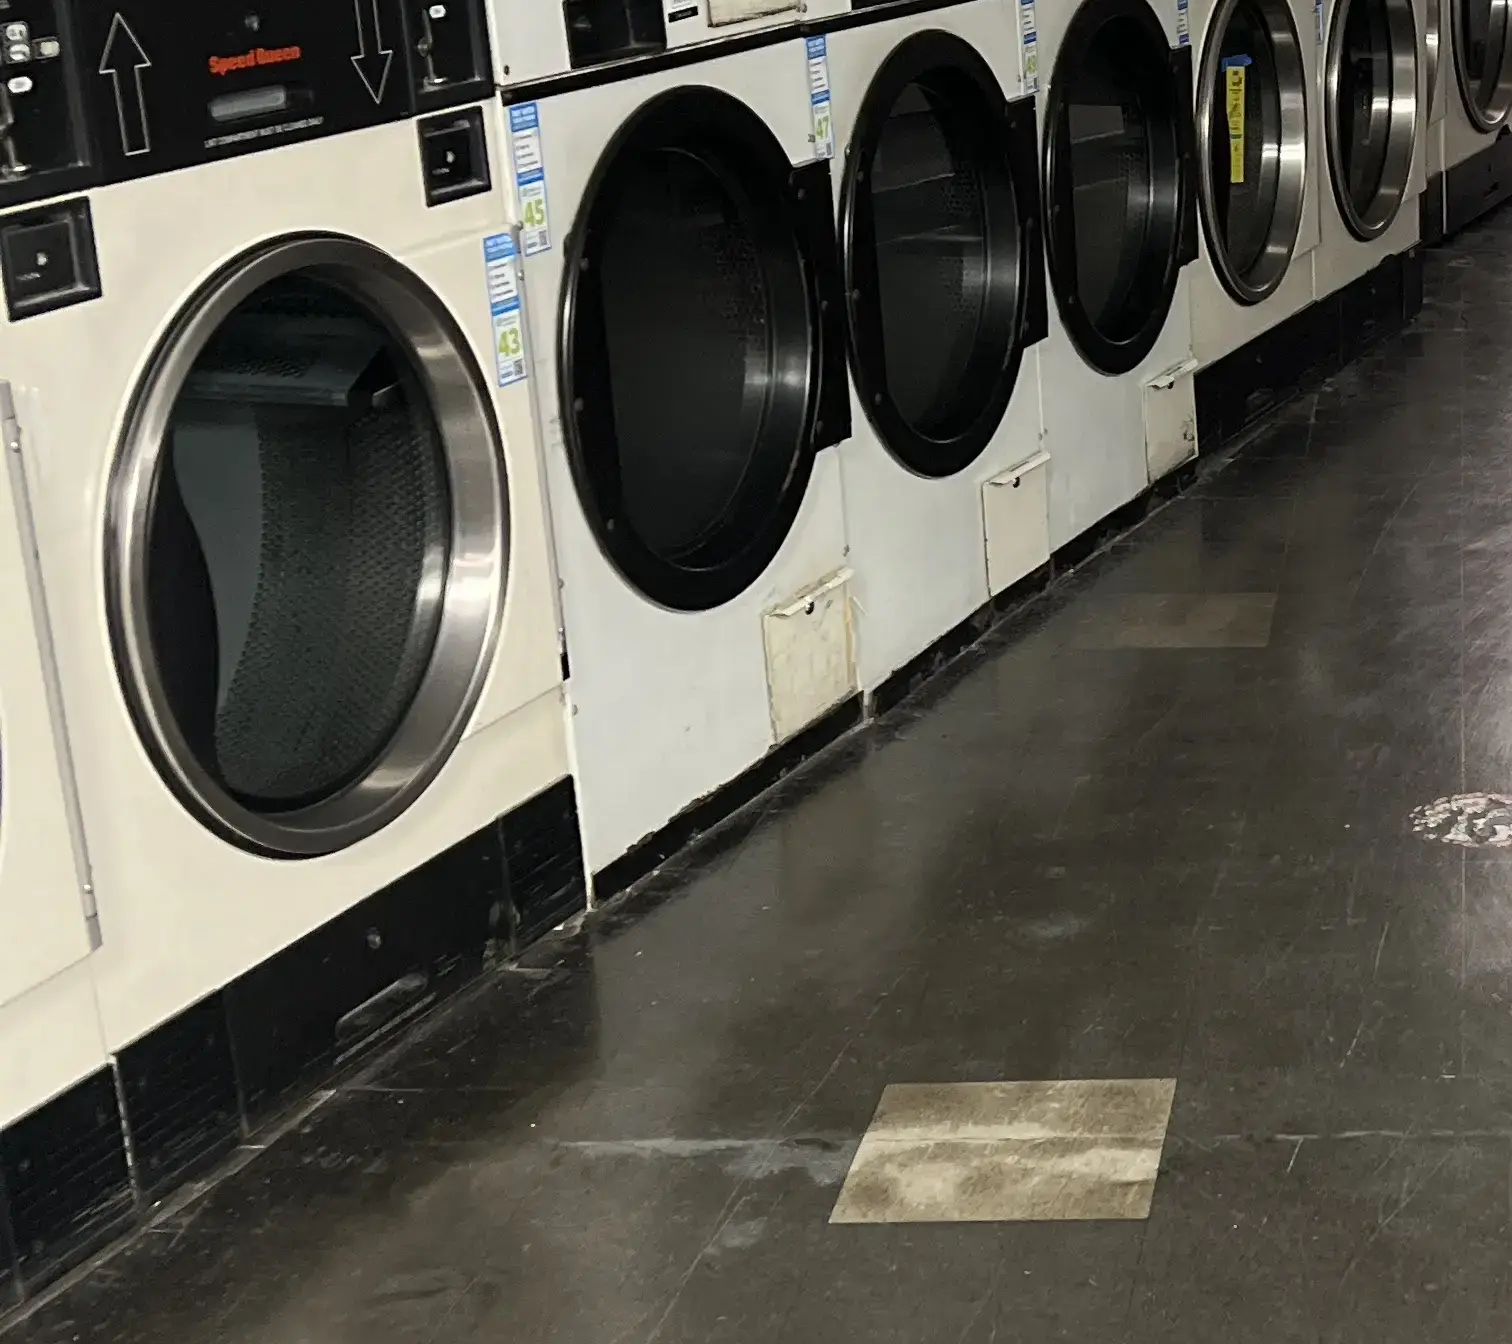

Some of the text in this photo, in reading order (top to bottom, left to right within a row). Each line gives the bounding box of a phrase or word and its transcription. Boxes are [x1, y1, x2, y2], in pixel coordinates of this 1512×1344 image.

[209, 45, 301, 76] Speed Queen
[523, 198, 545, 228] 45
[498, 327, 521, 358] 43
